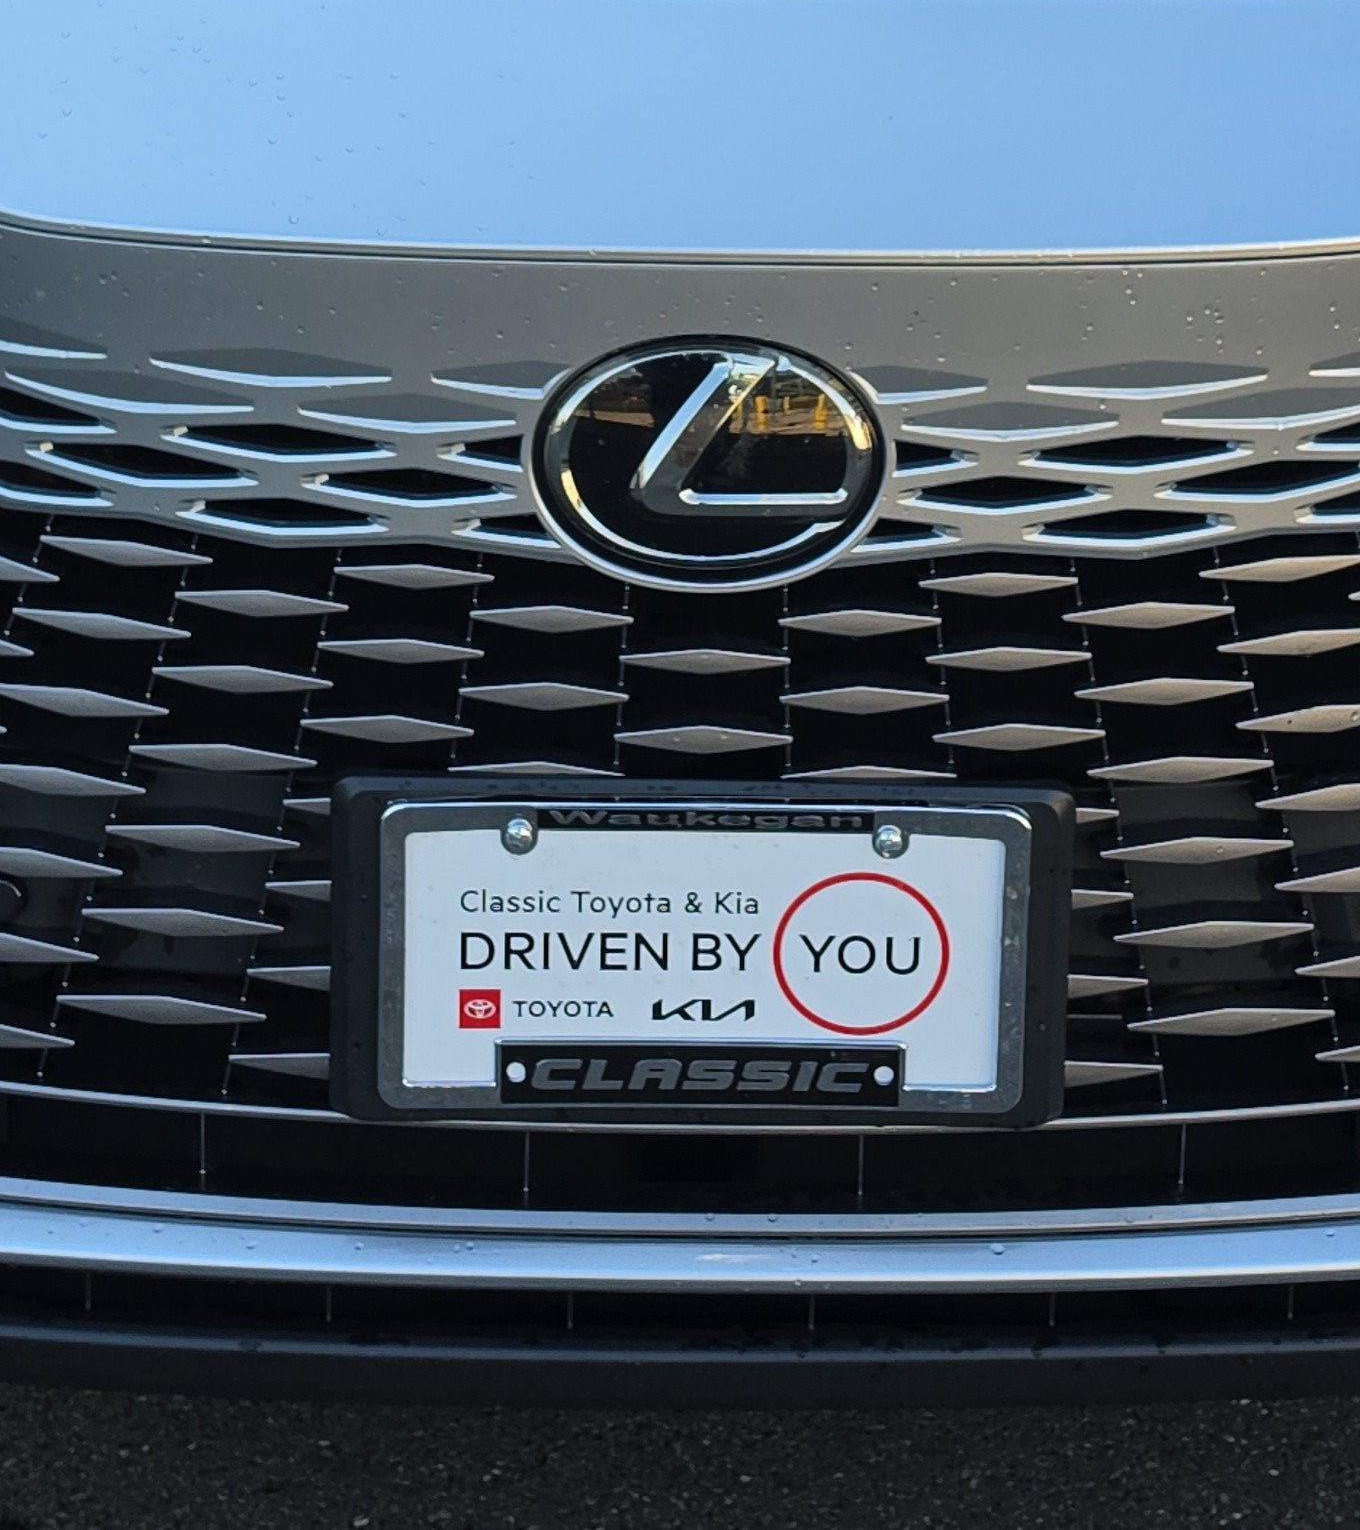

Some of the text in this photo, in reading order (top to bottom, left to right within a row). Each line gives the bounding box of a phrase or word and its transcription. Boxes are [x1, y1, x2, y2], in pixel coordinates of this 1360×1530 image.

[548, 809, 863, 829] Waukegan
[460, 889, 759, 919] Classic Toyota & Kia
[460, 931, 922, 975] DRIVEN BY YOU
[512, 999, 756, 1022] TOYOTA KIA
[530, 1058, 871, 1093] CLASSIC
